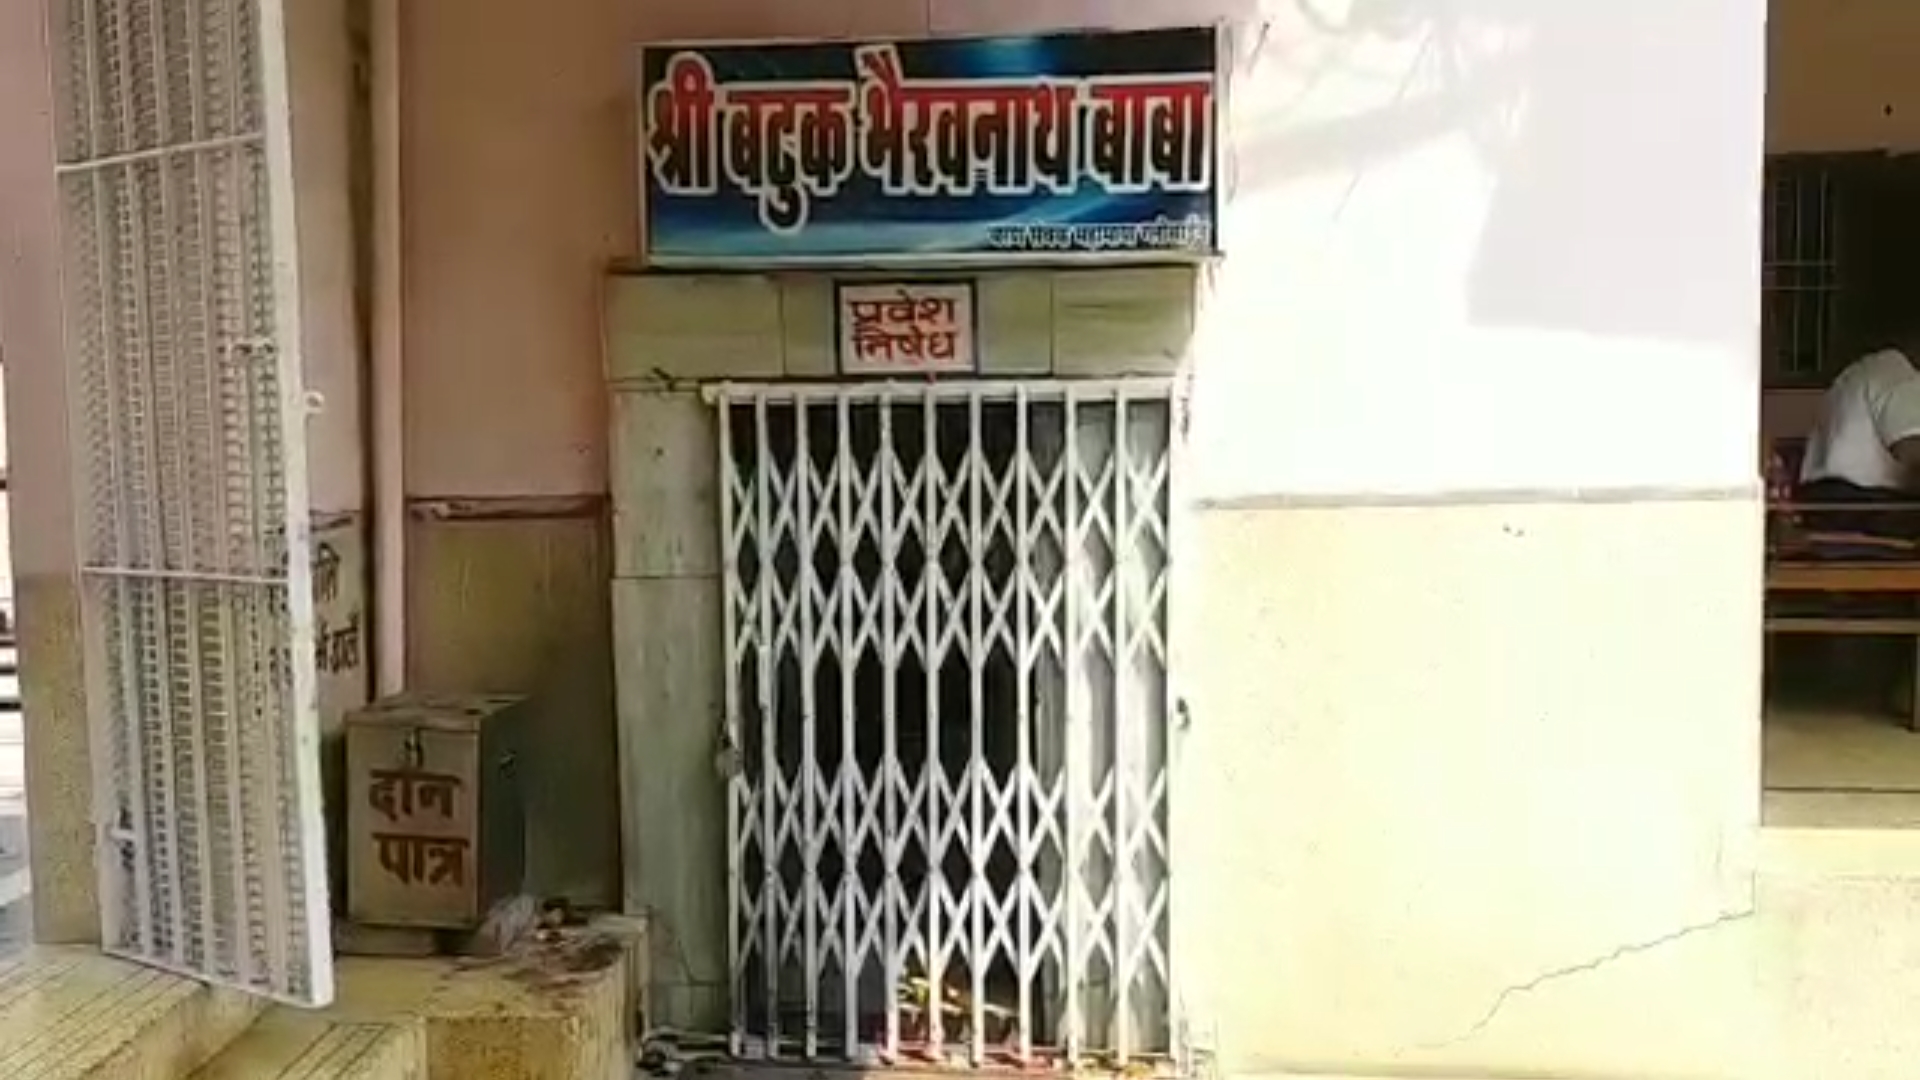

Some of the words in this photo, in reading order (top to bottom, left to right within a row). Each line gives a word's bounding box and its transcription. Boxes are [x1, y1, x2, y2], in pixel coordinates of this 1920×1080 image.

[648, 52, 717, 193] श्री
[724, 81, 855, 231] बटुक
[857, 46, 1079, 194] भैरवनाथ
[1085, 74, 1212, 191] बाबा
[848, 289, 957, 326] प्रवेश
[852, 326, 958, 361] निषेध
[369, 769, 463, 822] दान
[372, 832, 470, 887] पात्र
